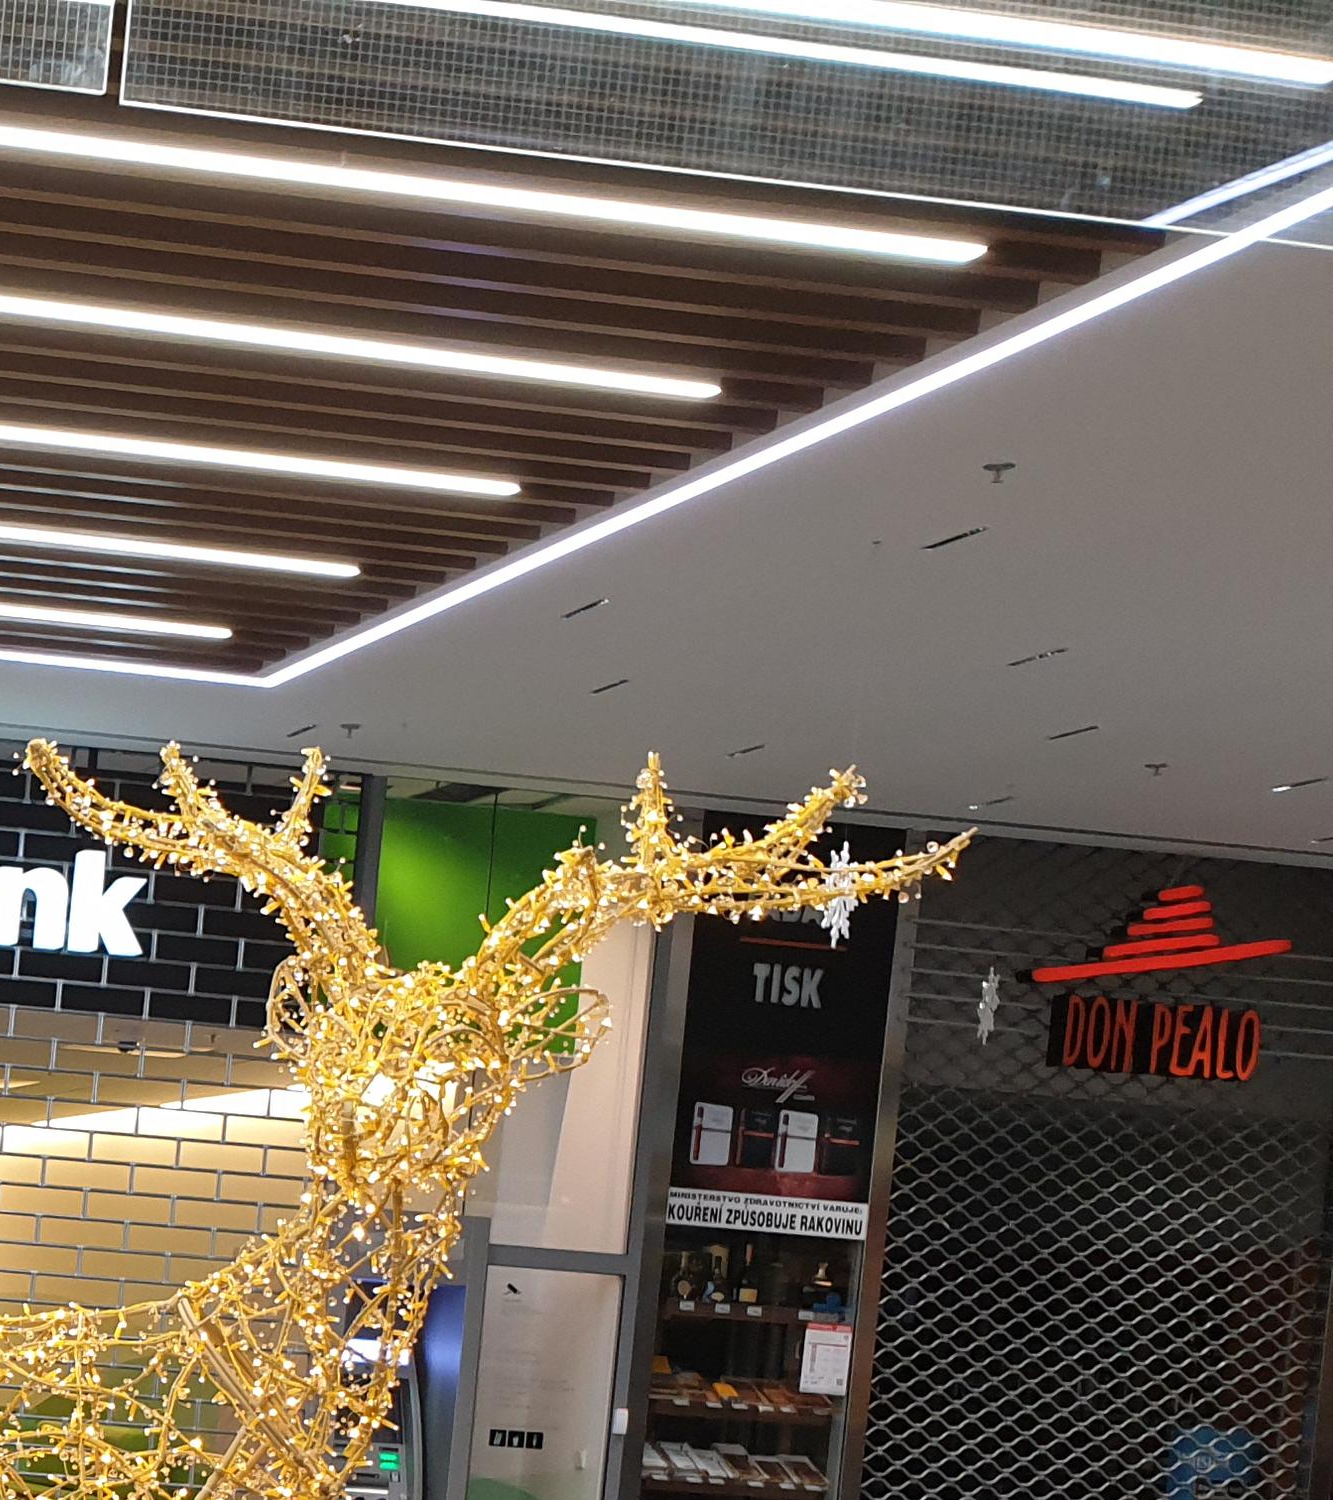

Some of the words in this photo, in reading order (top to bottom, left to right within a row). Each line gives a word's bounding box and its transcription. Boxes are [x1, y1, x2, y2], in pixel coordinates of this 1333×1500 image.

[753, 962, 824, 1009] TISK
[1062, 994, 1138, 1073] DON
[1148, 1002, 1263, 1082] PEALO
[669, 1191, 741, 1204] MINISTERSTVO
[667, 1201, 723, 1224] KOUŘENÍ
[725, 1202, 797, 1230] ZPŮSOBUJE
[799, 1214, 863, 1236] RAKOVINU
